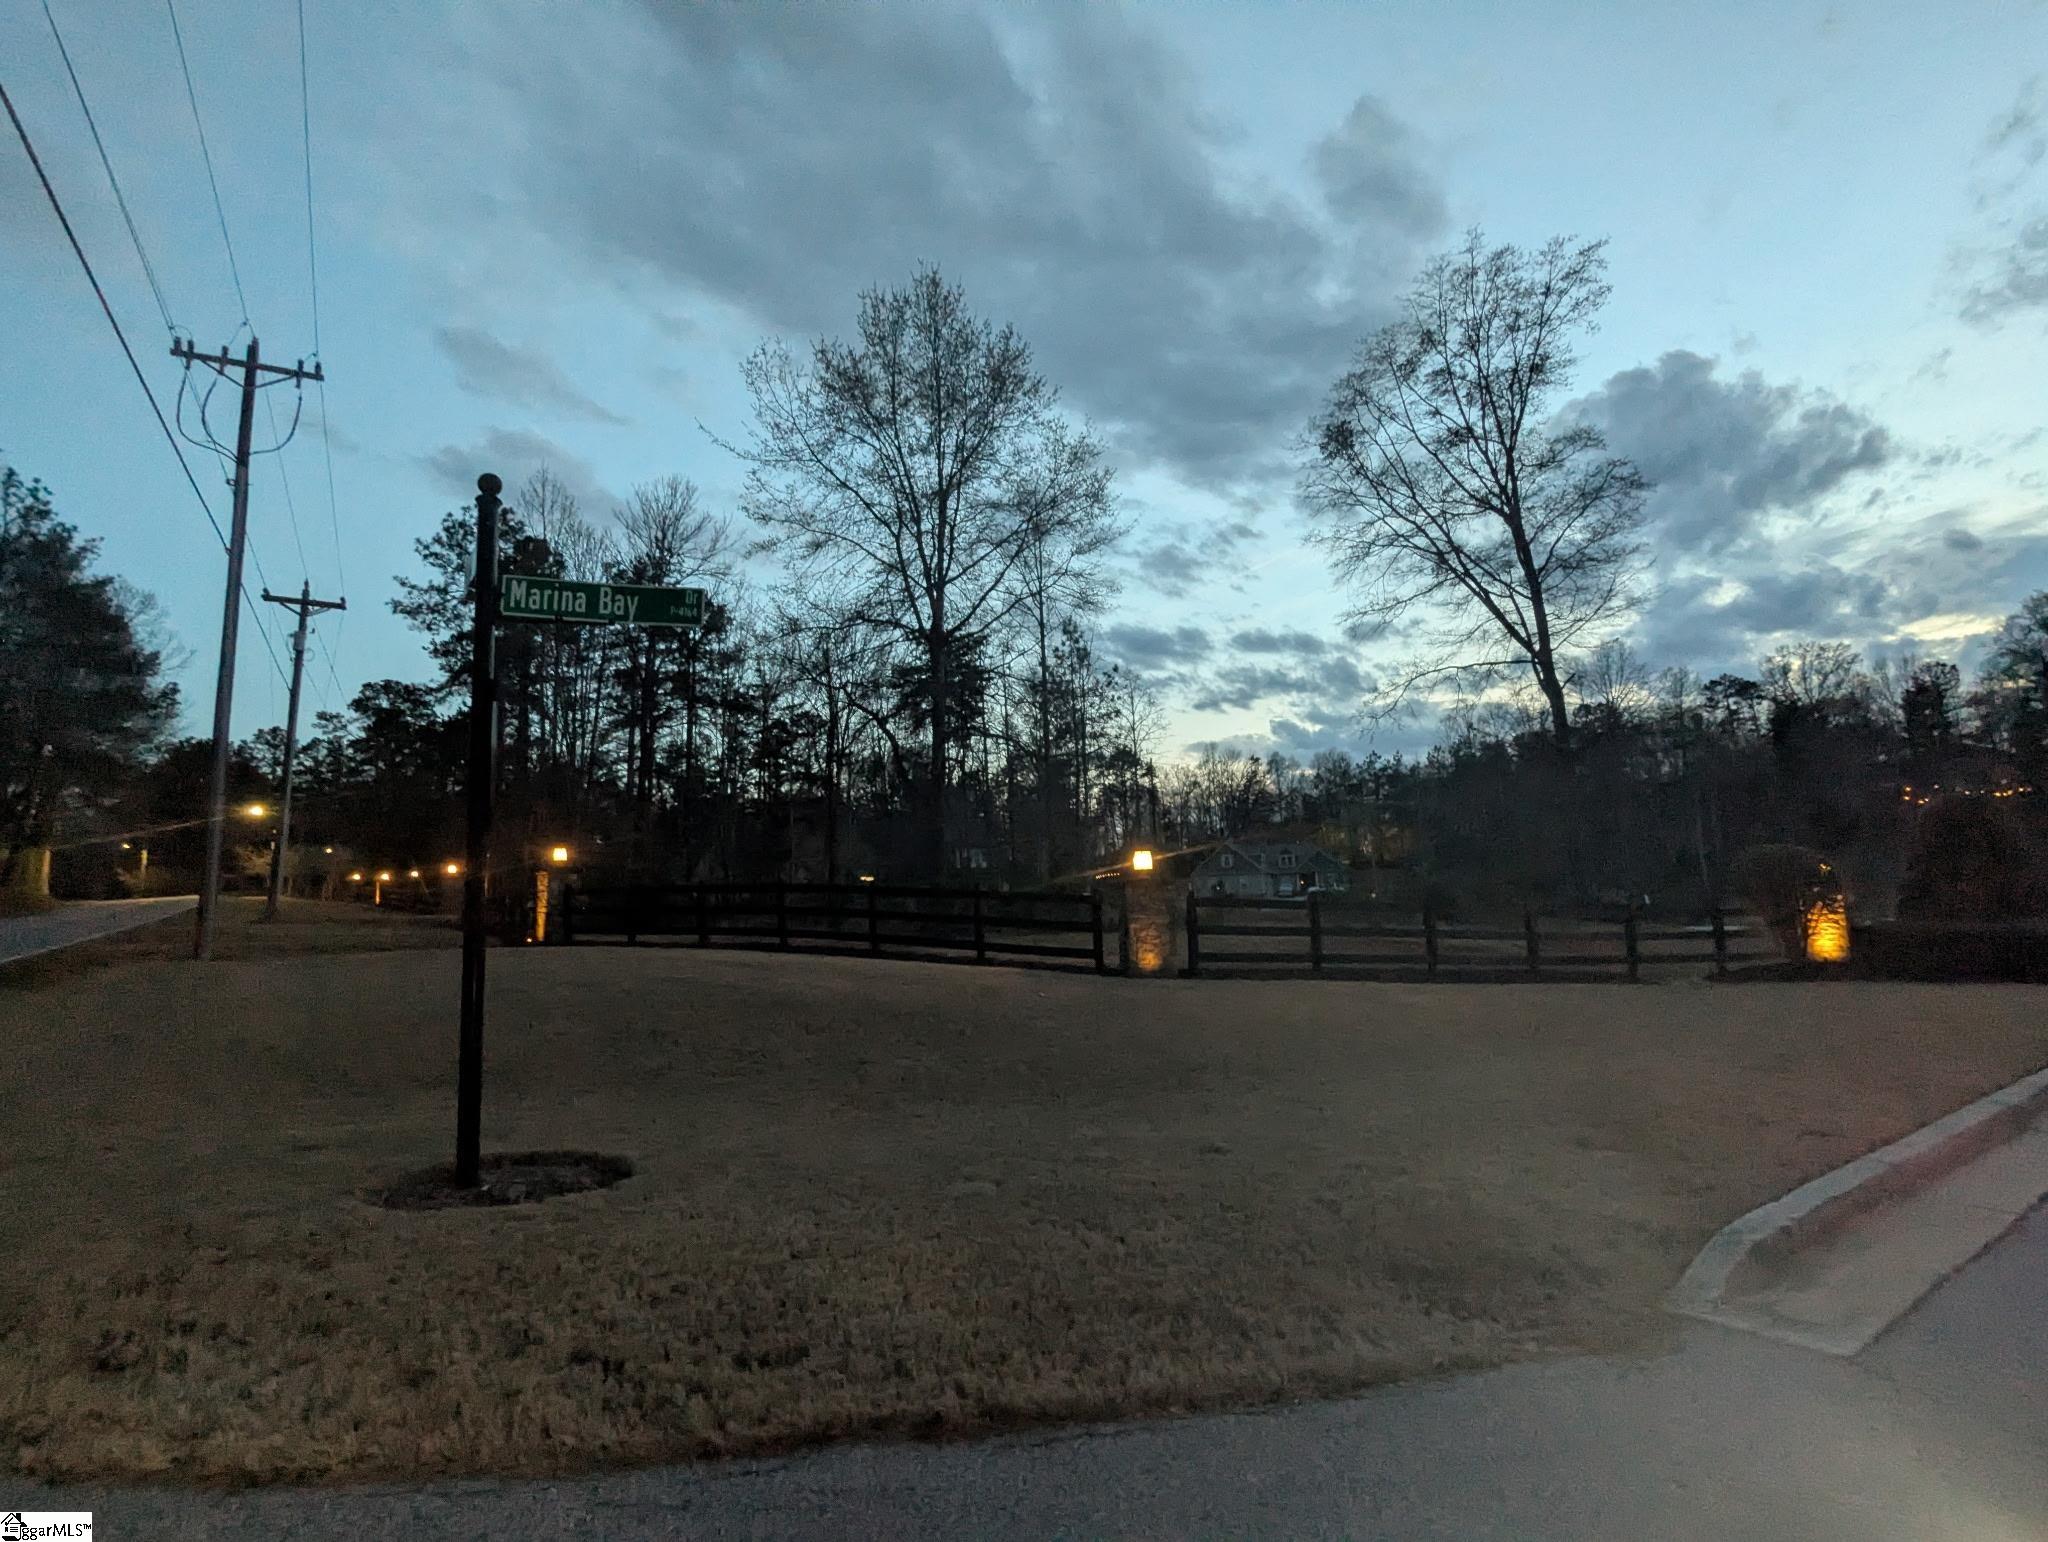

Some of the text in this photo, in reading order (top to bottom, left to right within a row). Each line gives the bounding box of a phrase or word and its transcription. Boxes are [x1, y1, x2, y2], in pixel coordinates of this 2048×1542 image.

[509, 579, 639, 622] Marina Bay
[685, 590, 699, 605] Dr
